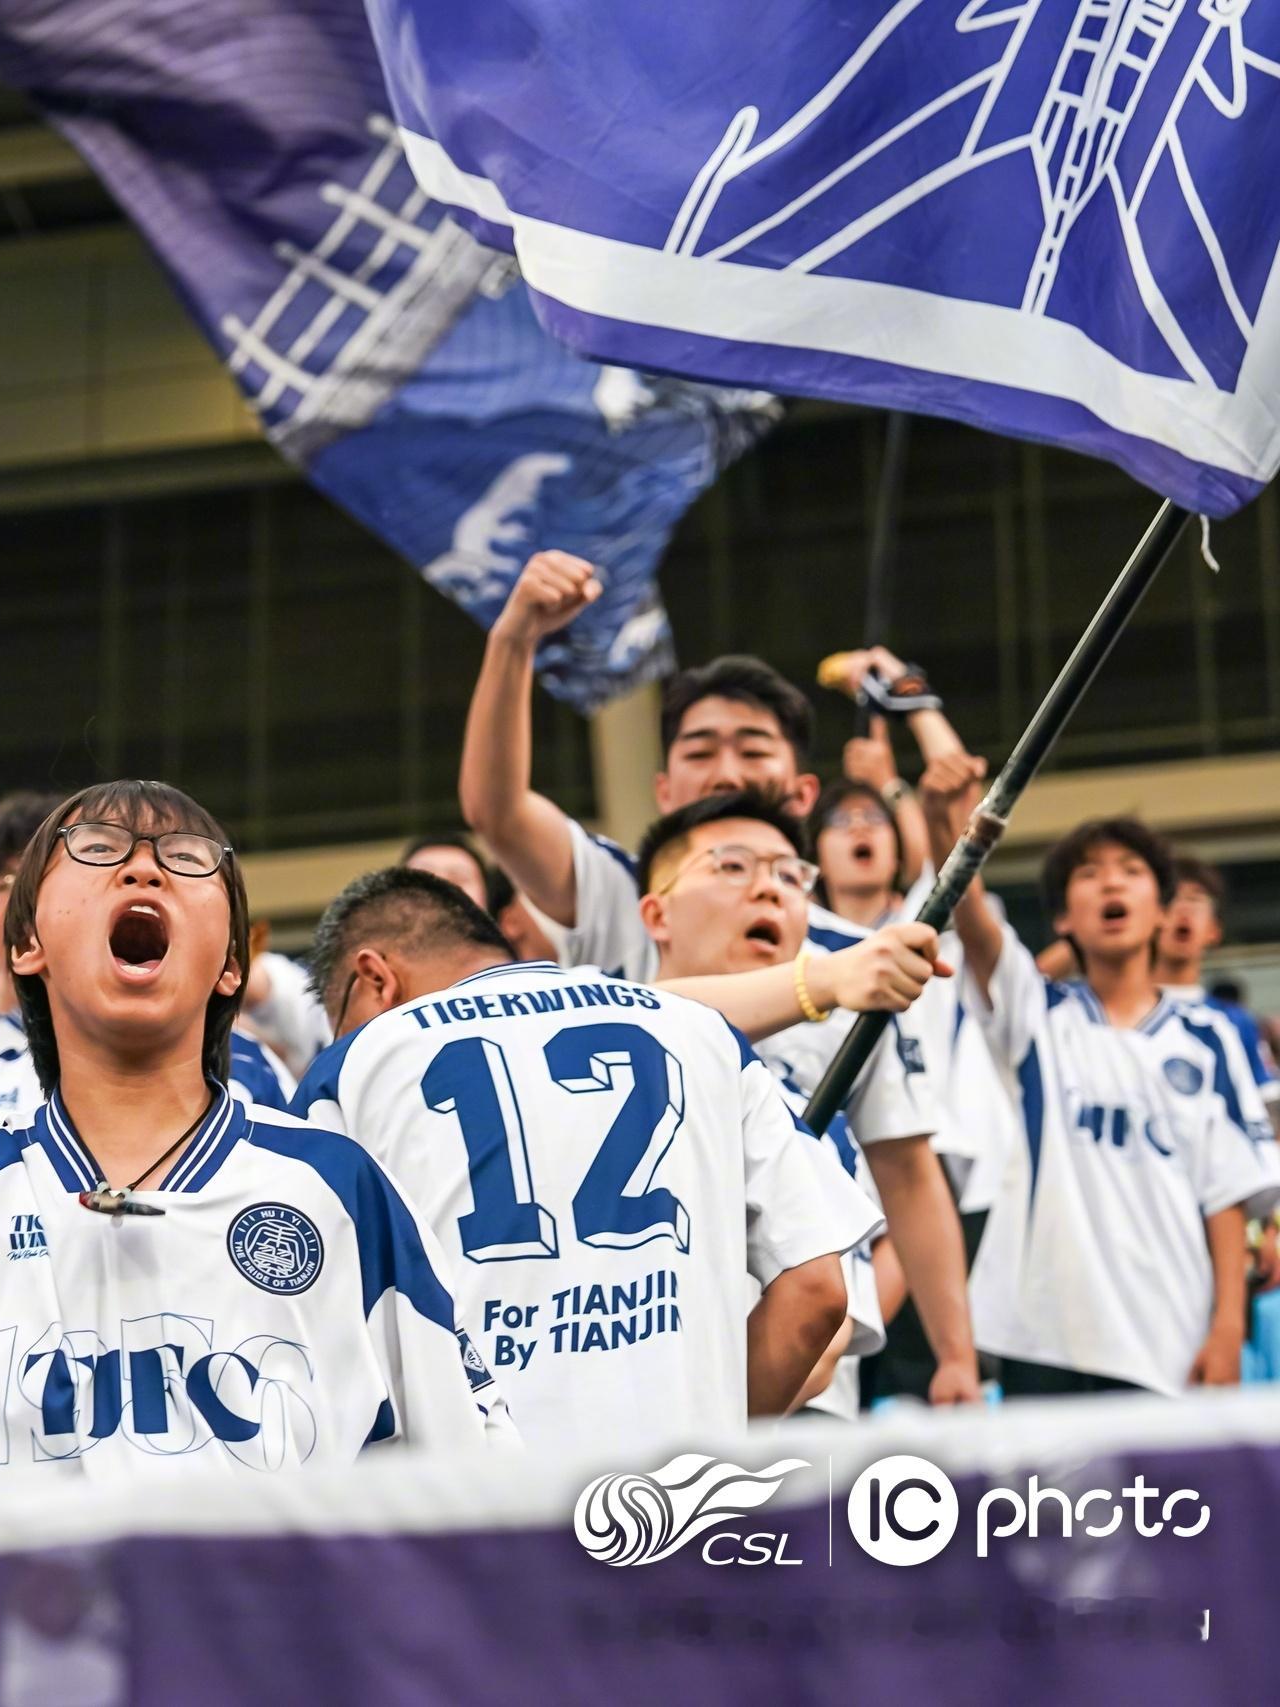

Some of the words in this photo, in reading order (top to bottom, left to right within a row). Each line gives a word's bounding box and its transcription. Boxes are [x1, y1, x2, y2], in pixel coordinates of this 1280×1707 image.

[402, 983, 661, 1029] TIGERWINGS
[420, 1022, 690, 1264] 12
[234, 1240, 246, 1259] THE
[242, 1260, 270, 1284] PRIDE
[272, 1279, 286, 1287] OF
[287, 1261, 316, 1287] TIANJIN
[483, 1299, 539, 1332] For
[494, 1335, 538, 1371] By
